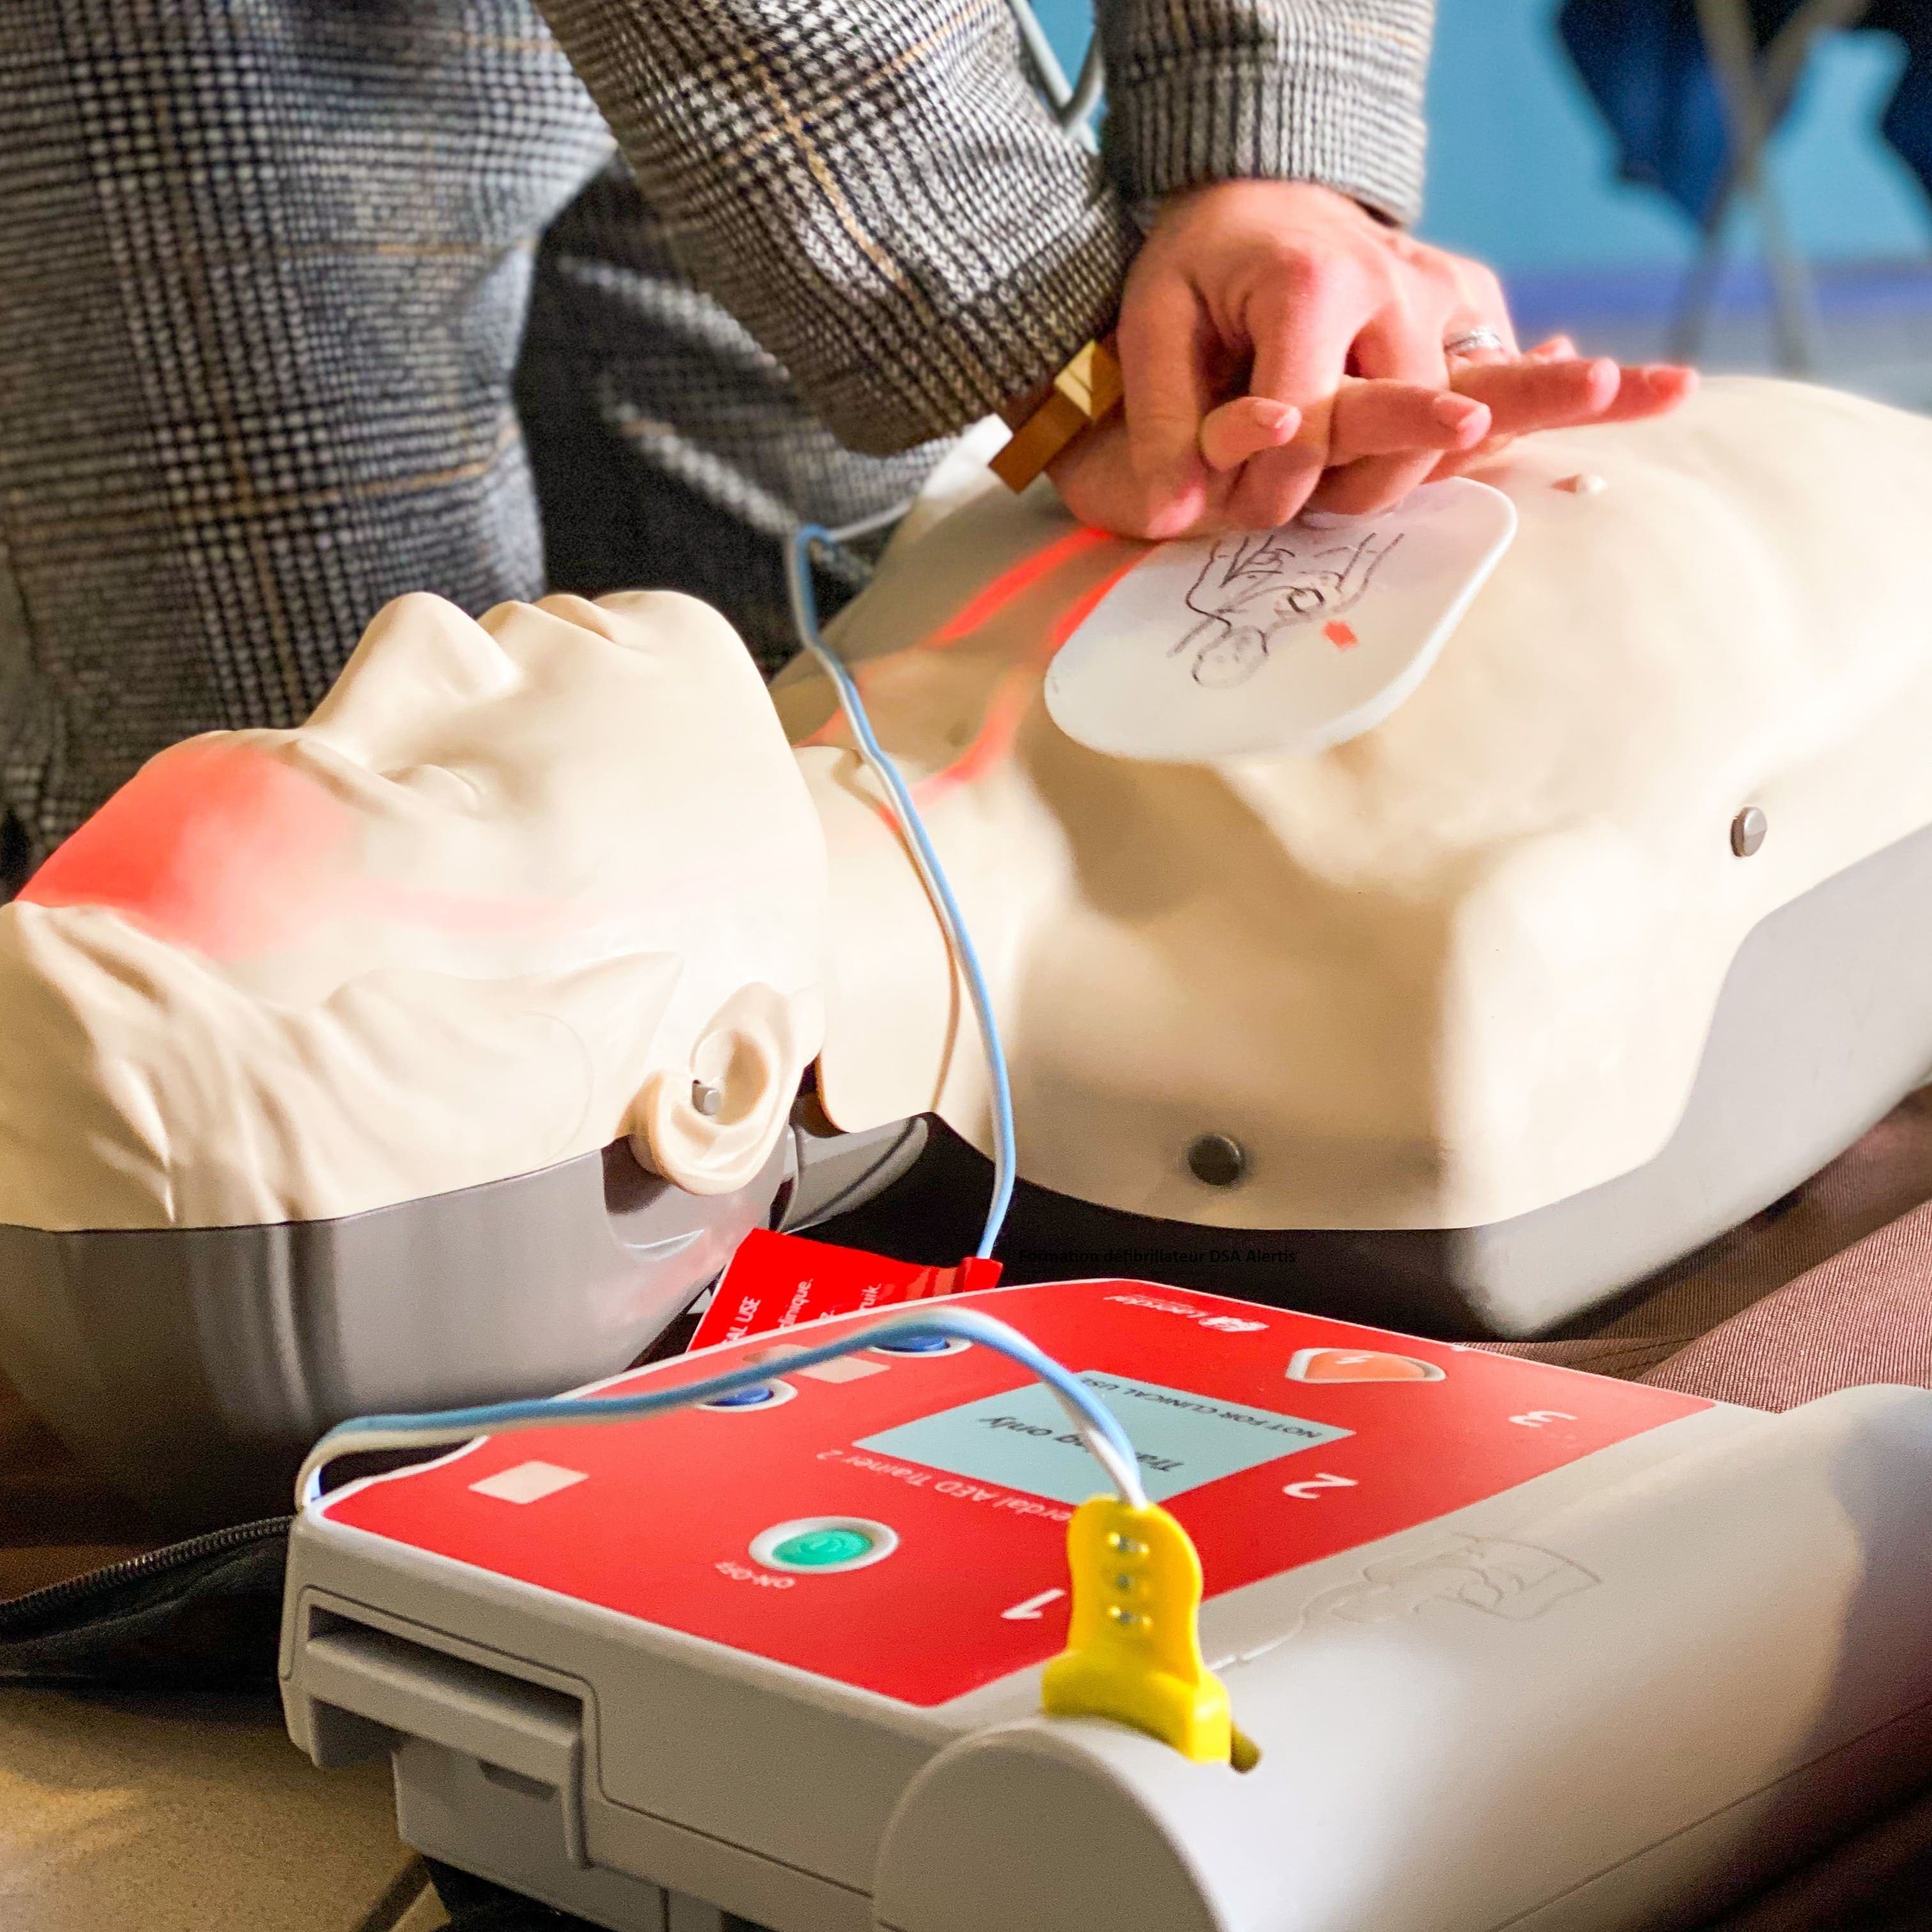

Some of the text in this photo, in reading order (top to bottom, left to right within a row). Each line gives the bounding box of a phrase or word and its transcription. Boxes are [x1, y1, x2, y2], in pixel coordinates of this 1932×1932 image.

[735, 1296, 761, 1323] USE
[1123, 1388, 1219, 1414] CLINICAL
[978, 1416, 1053, 1436] only
[1218, 1411, 1269, 1426] FOR
[1266, 1423, 1322, 1439] NOT
[1508, 1409, 1578, 1429] 3
[816, 1449, 1073, 1522] erdal AED Trainer 2
[1282, 1471, 1359, 1500] 2
[999, 1588, 1067, 1620] 1
